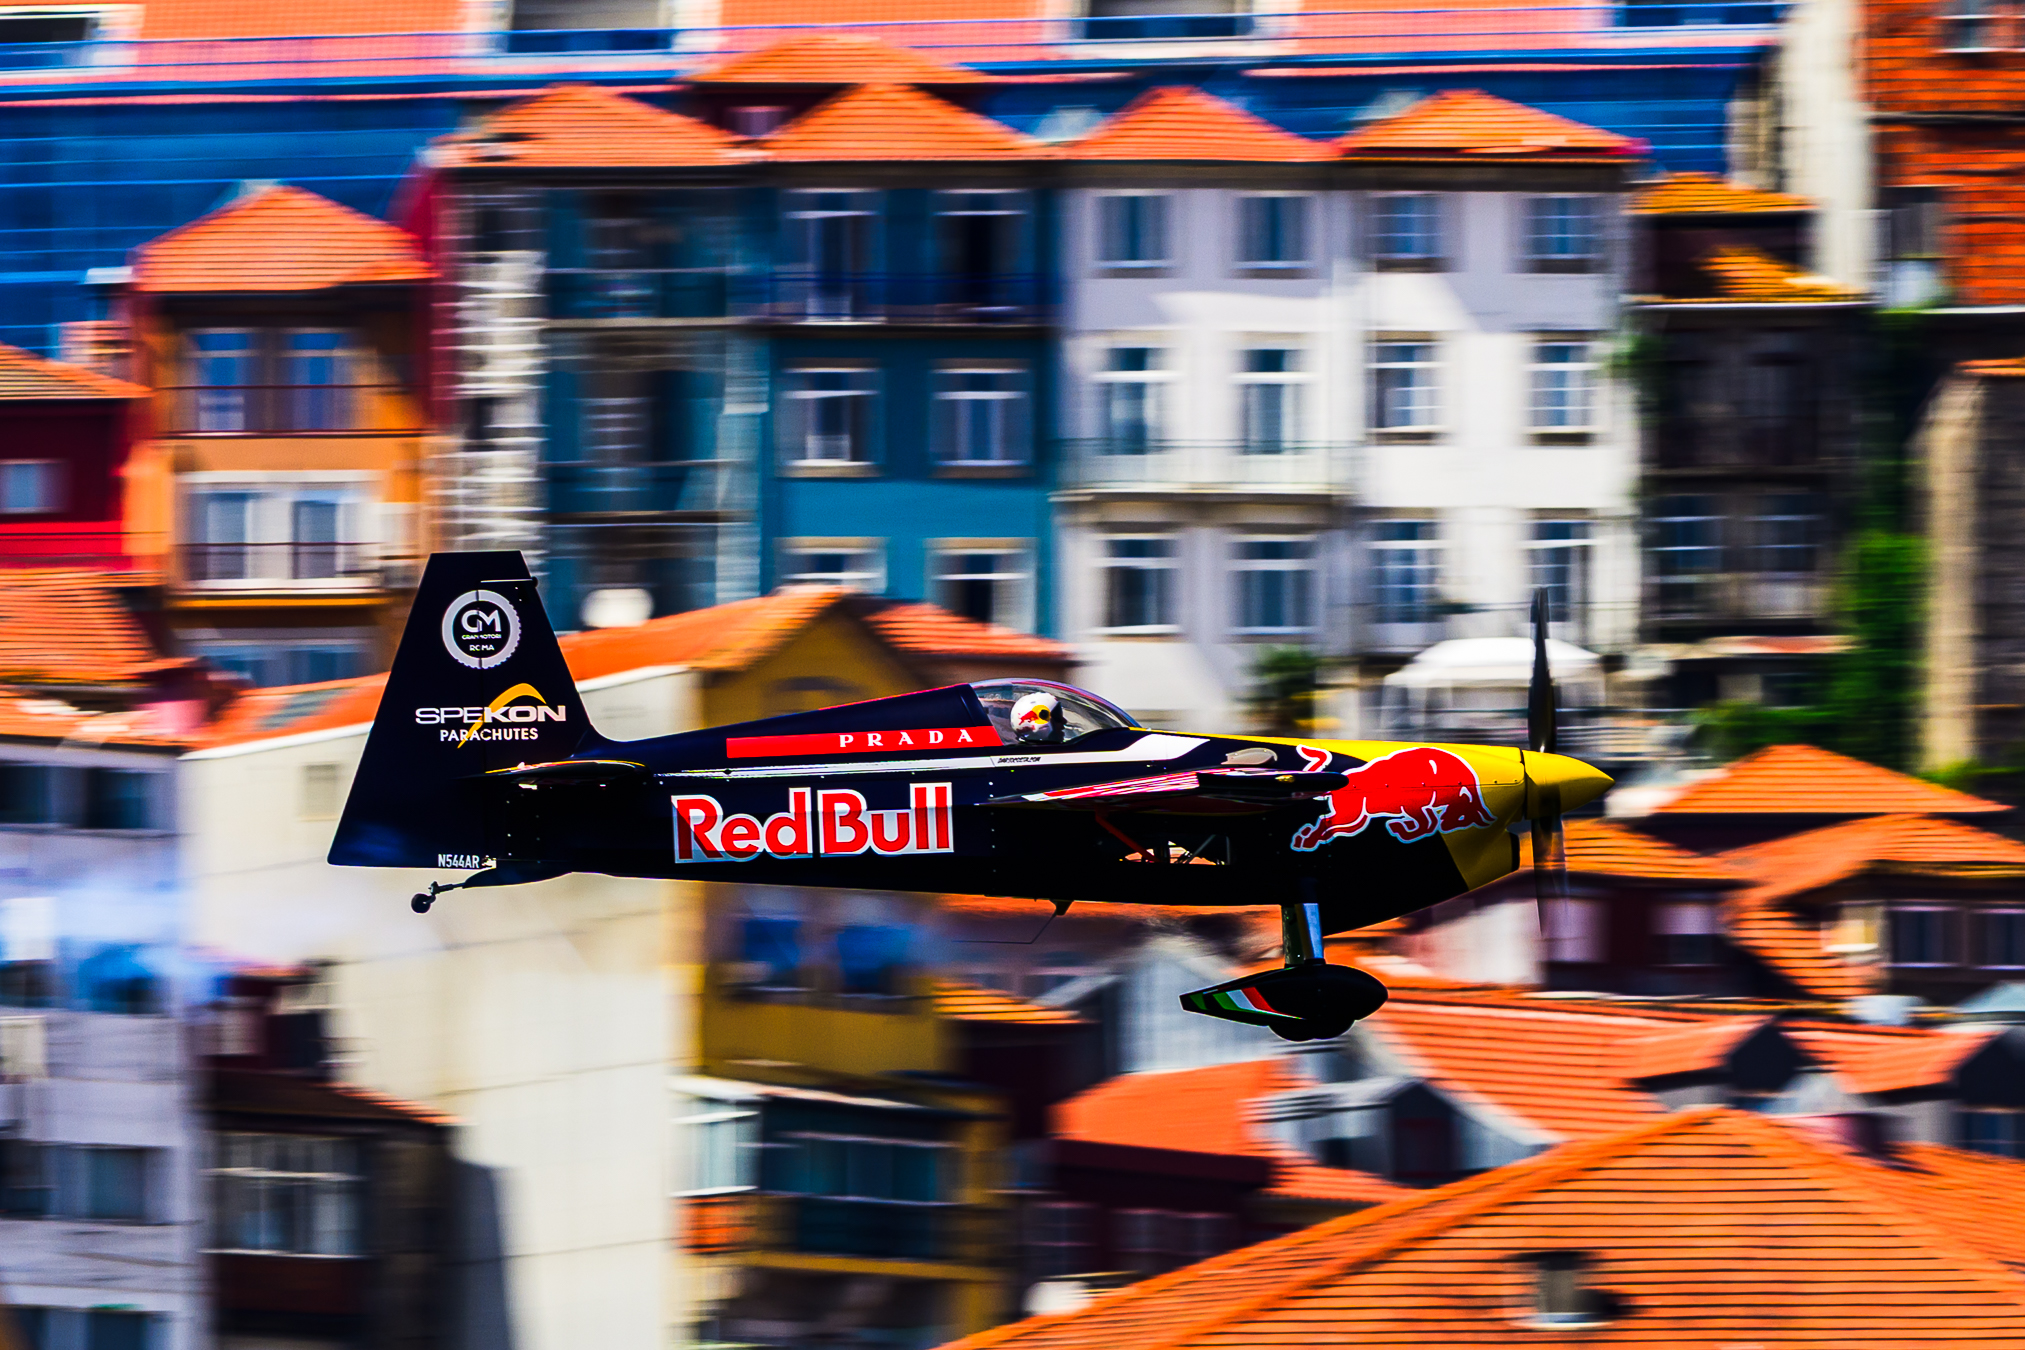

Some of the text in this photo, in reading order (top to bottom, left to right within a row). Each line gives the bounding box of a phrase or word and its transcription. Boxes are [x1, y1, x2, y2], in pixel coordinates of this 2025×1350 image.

[461, 609, 502, 633] GM
[415, 705, 567, 724] SPEKON
[440, 728, 539, 742] PARACHUTES
[839, 729, 973, 748] PRADA
[671, 782, 955, 864] Red Bull
[437, 853, 480, 868] N544AR
